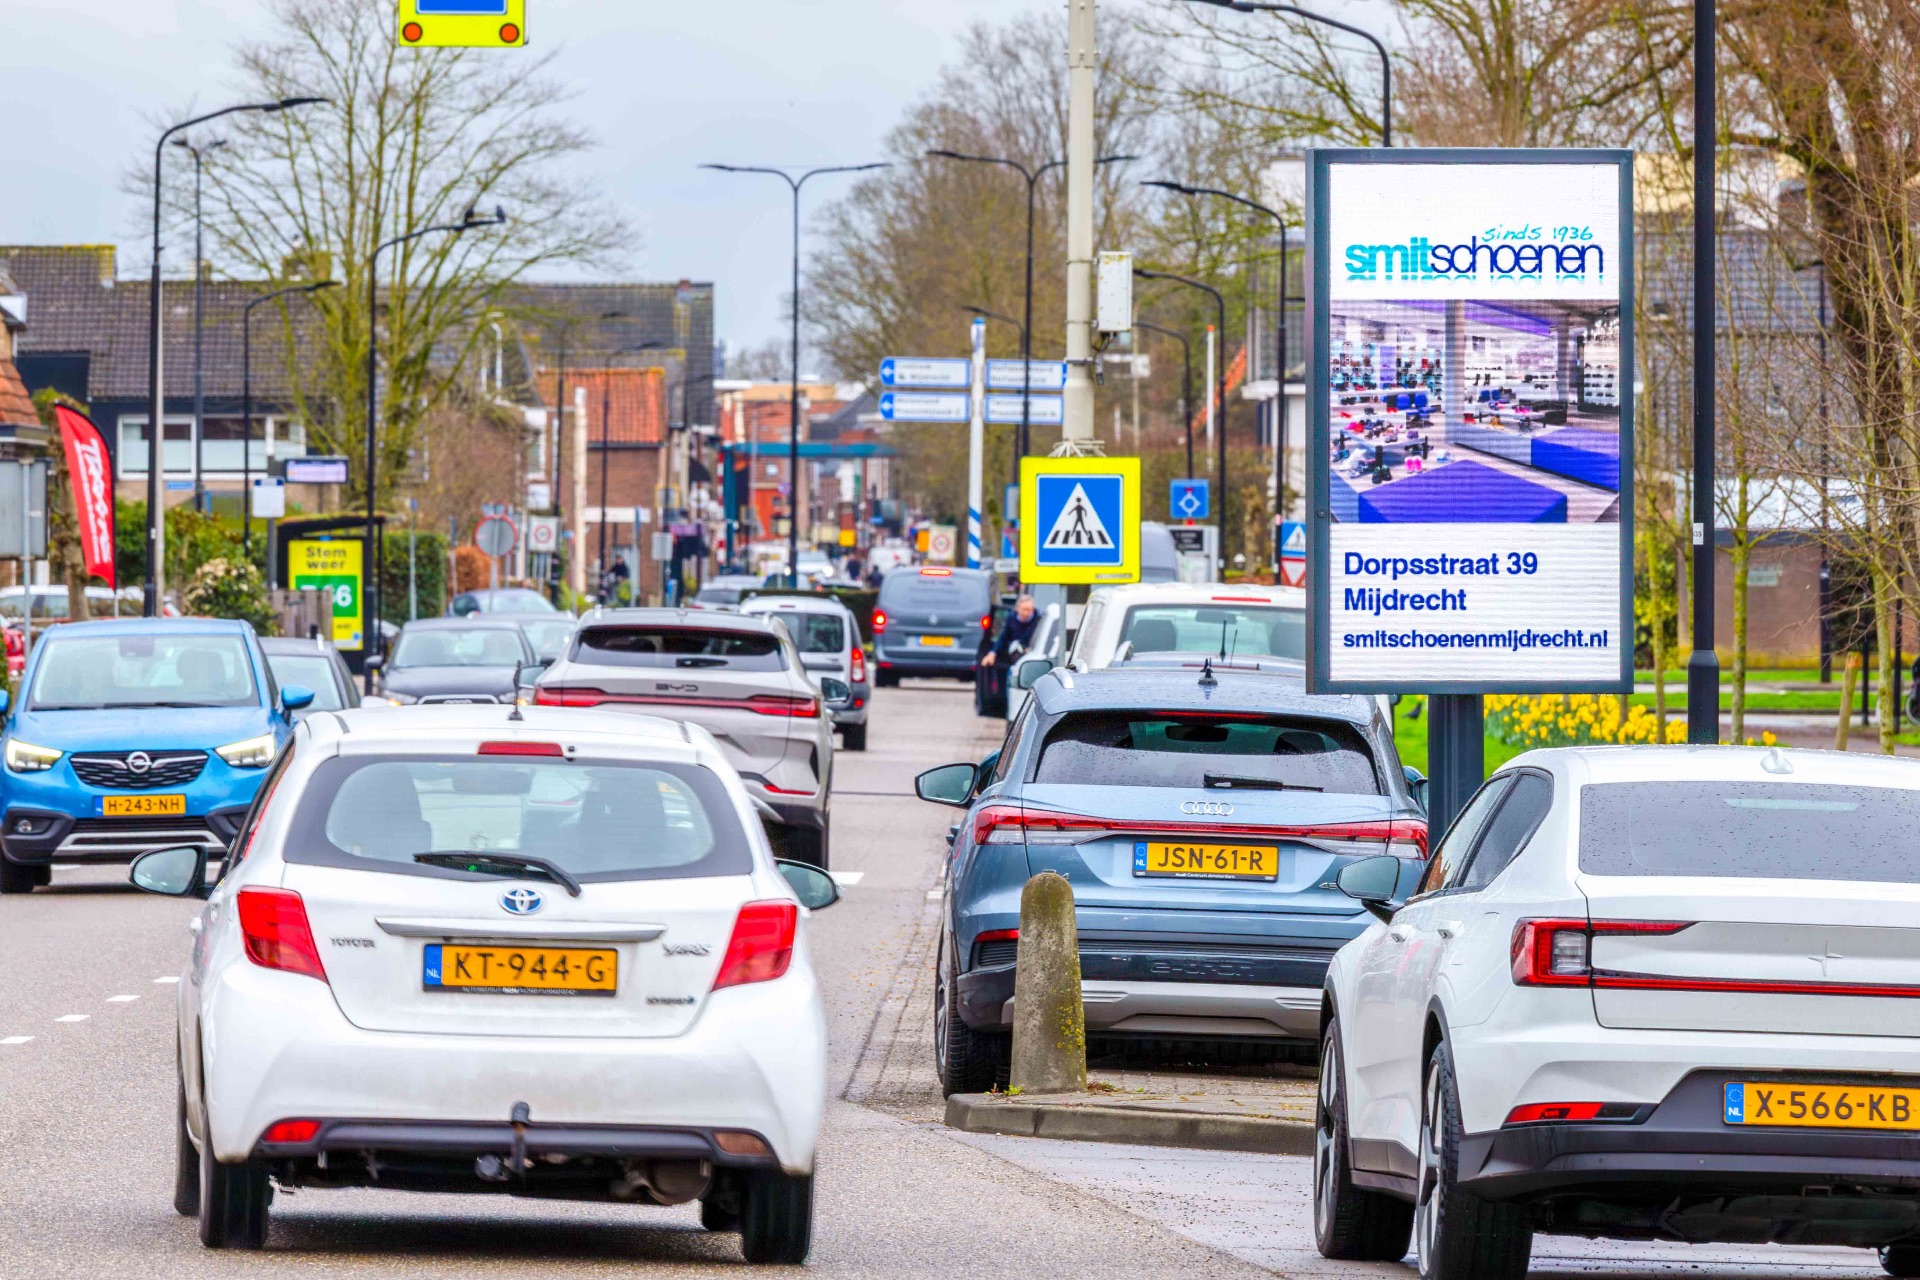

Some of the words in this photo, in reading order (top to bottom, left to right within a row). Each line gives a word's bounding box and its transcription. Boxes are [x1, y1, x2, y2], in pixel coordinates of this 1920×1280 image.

[1481, 223, 1543, 242] sinds
[1552, 225, 1594, 242] 1936
[1344, 235, 1604, 274] smitschoenen
[306, 546, 347, 557] Stem
[1344, 551, 1499, 580] Dorpsstraat
[1506, 551, 1539, 575] 39
[1344, 587, 1467, 615] Mijdrecht
[107, 797, 180, 812] H-243-NH
[1135, 859, 1146, 867] NL
[1157, 846, 1264, 871] JSN-61-R
[330, 936, 376, 948] TOYOTA
[455, 952, 605, 983] KT-944-G
[1728, 1106, 1742, 1116] NL
[1755, 1089, 1911, 1122] X-566-KB
